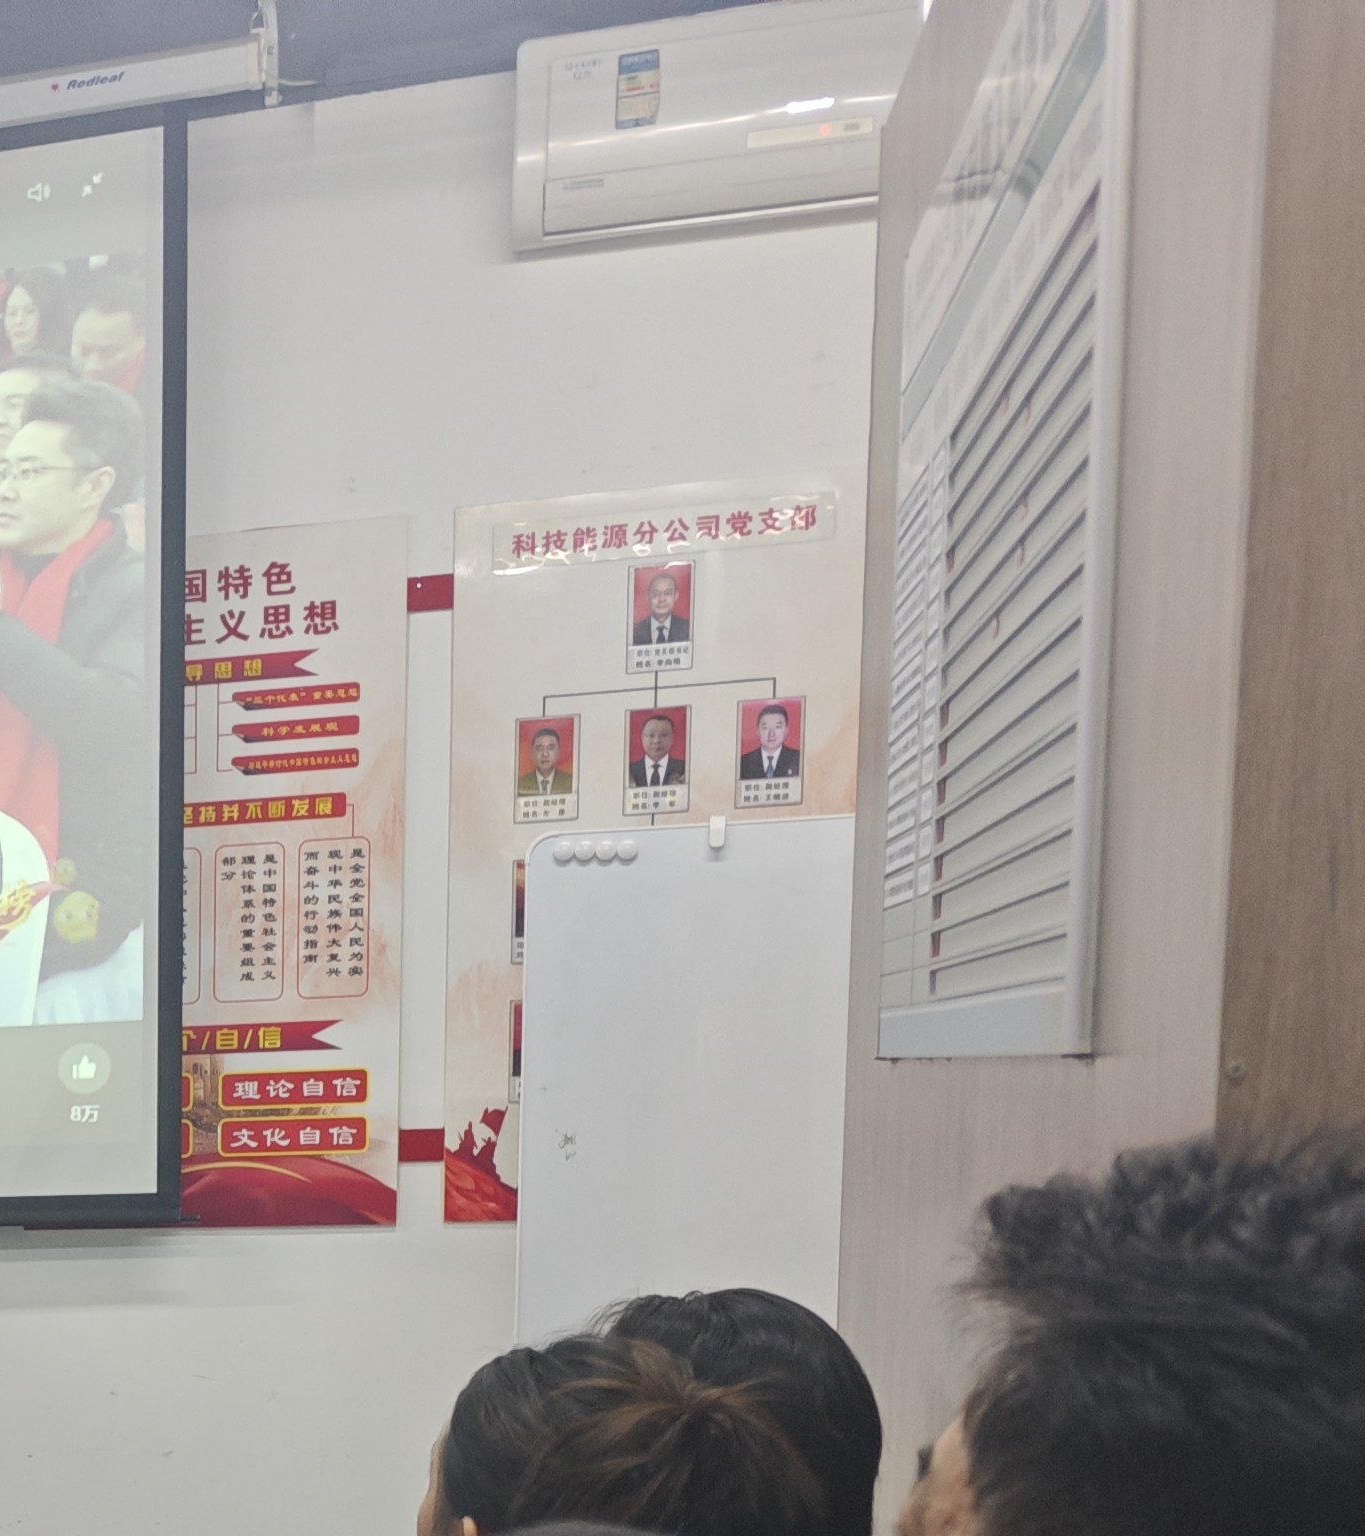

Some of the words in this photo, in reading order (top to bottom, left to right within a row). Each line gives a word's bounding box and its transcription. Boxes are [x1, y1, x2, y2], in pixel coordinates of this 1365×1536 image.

[512, 504, 817, 558] 科技能源分公司党支部
[185, 561, 296, 602] 国特色
[184, 600, 339, 646] 主义思想
[232, 1077, 361, 1100] 理论自信
[69, 1103, 99, 1124] 8万
[230, 1125, 357, 1148] 文化自信
